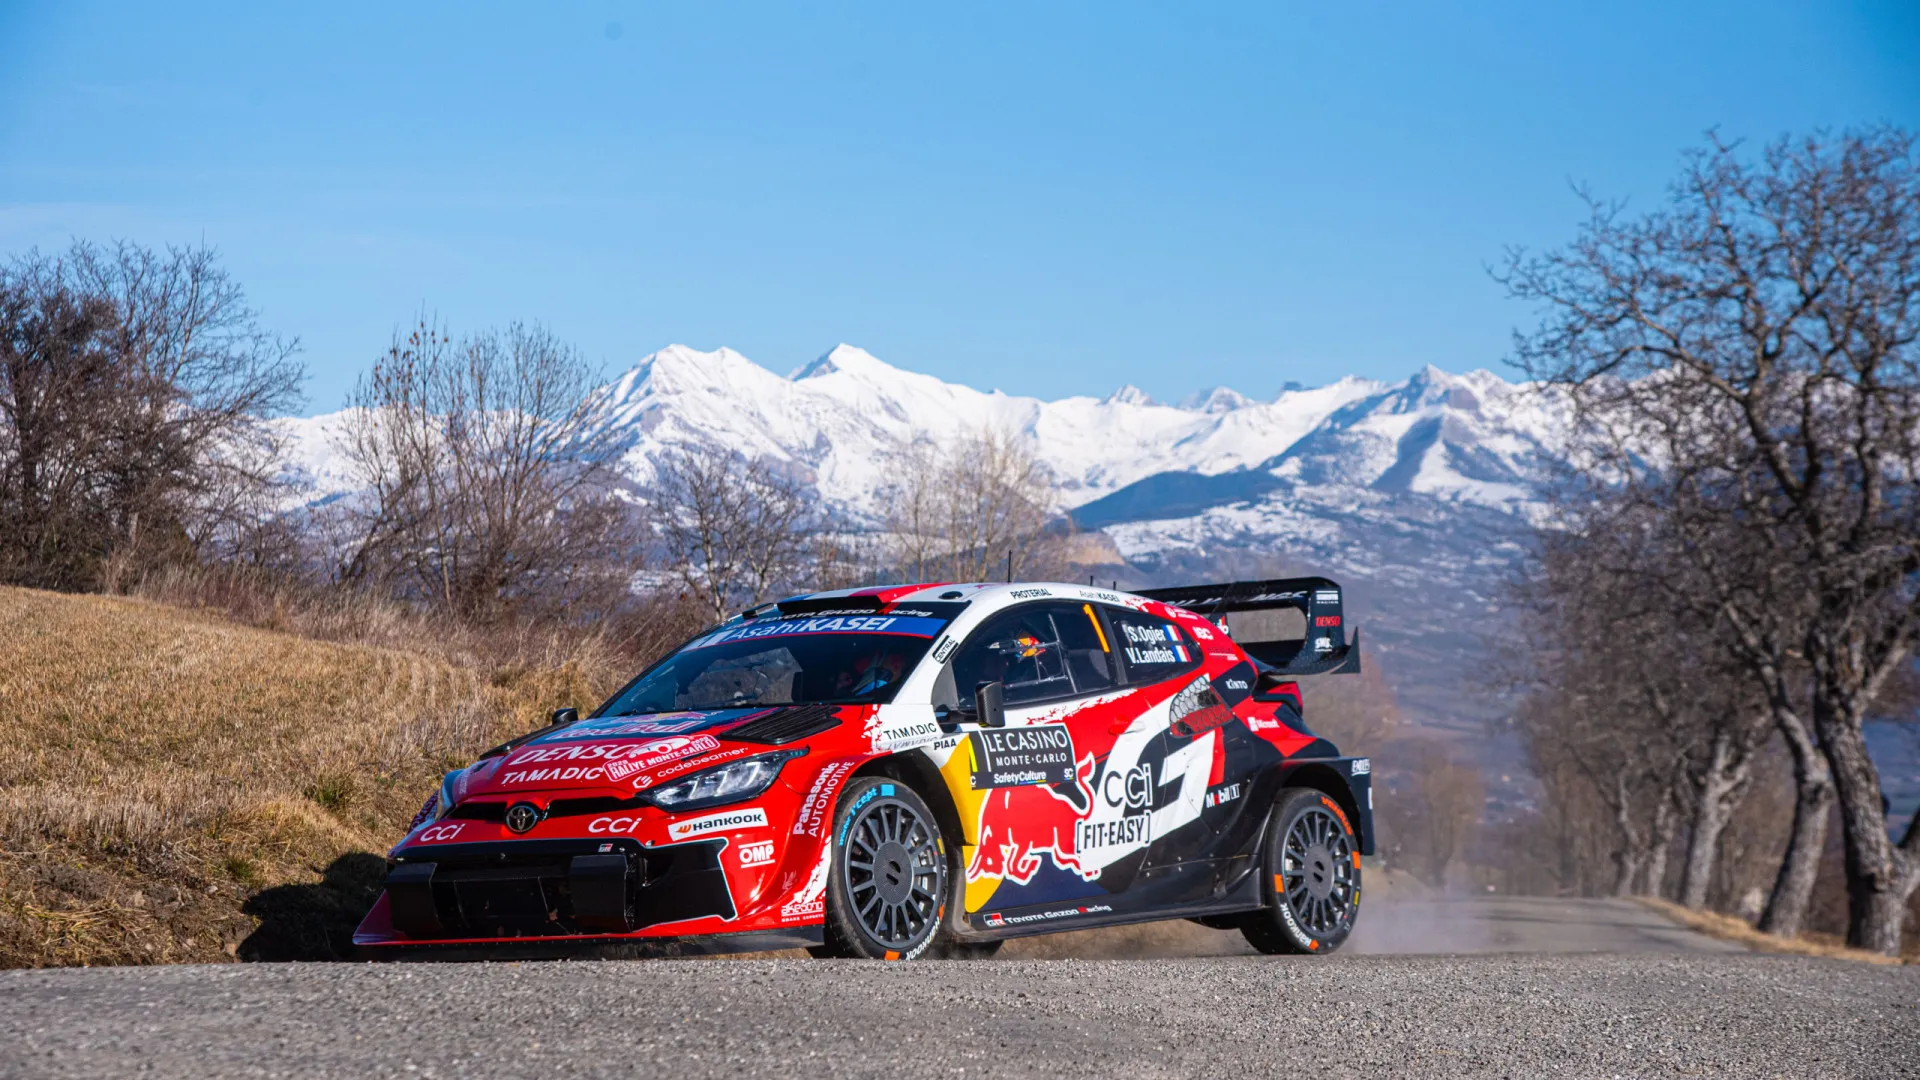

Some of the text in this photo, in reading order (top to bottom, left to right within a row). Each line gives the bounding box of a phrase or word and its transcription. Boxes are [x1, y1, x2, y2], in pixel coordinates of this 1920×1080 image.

[1010, 588, 1052, 599] PROTERIAL
[723, 617, 892, 640] AsahiKASEI
[1082, 603, 1110, 653] 1
[1315, 616, 1341, 627] DENSO
[1127, 625, 1167, 645] S.Ogier
[935, 639, 956, 662] CENTRAL
[1125, 646, 1176, 664] V.Landais
[883, 722, 937, 741] TAMADIC
[984, 729, 1068, 752] LE CASINO
[933, 738, 956, 751] PIAA
[508, 744, 634, 766] DENSO
[608, 738, 717, 780] RALLYE MONTE-CARLO
[657, 748, 746, 779] codebeamer
[500, 766, 604, 785] TAMADIC
[994, 771, 1047, 784] SafetyCulture
[792, 762, 840, 836] Panasonic
[807, 761, 855, 838] AUTOMOTIVE
[1206, 788, 1230, 808] Mobil
[738, 843, 775, 864] OMP
[1004, 914, 1045, 924] TOYOTA
[1045, 908, 1080, 919] GAZOO
